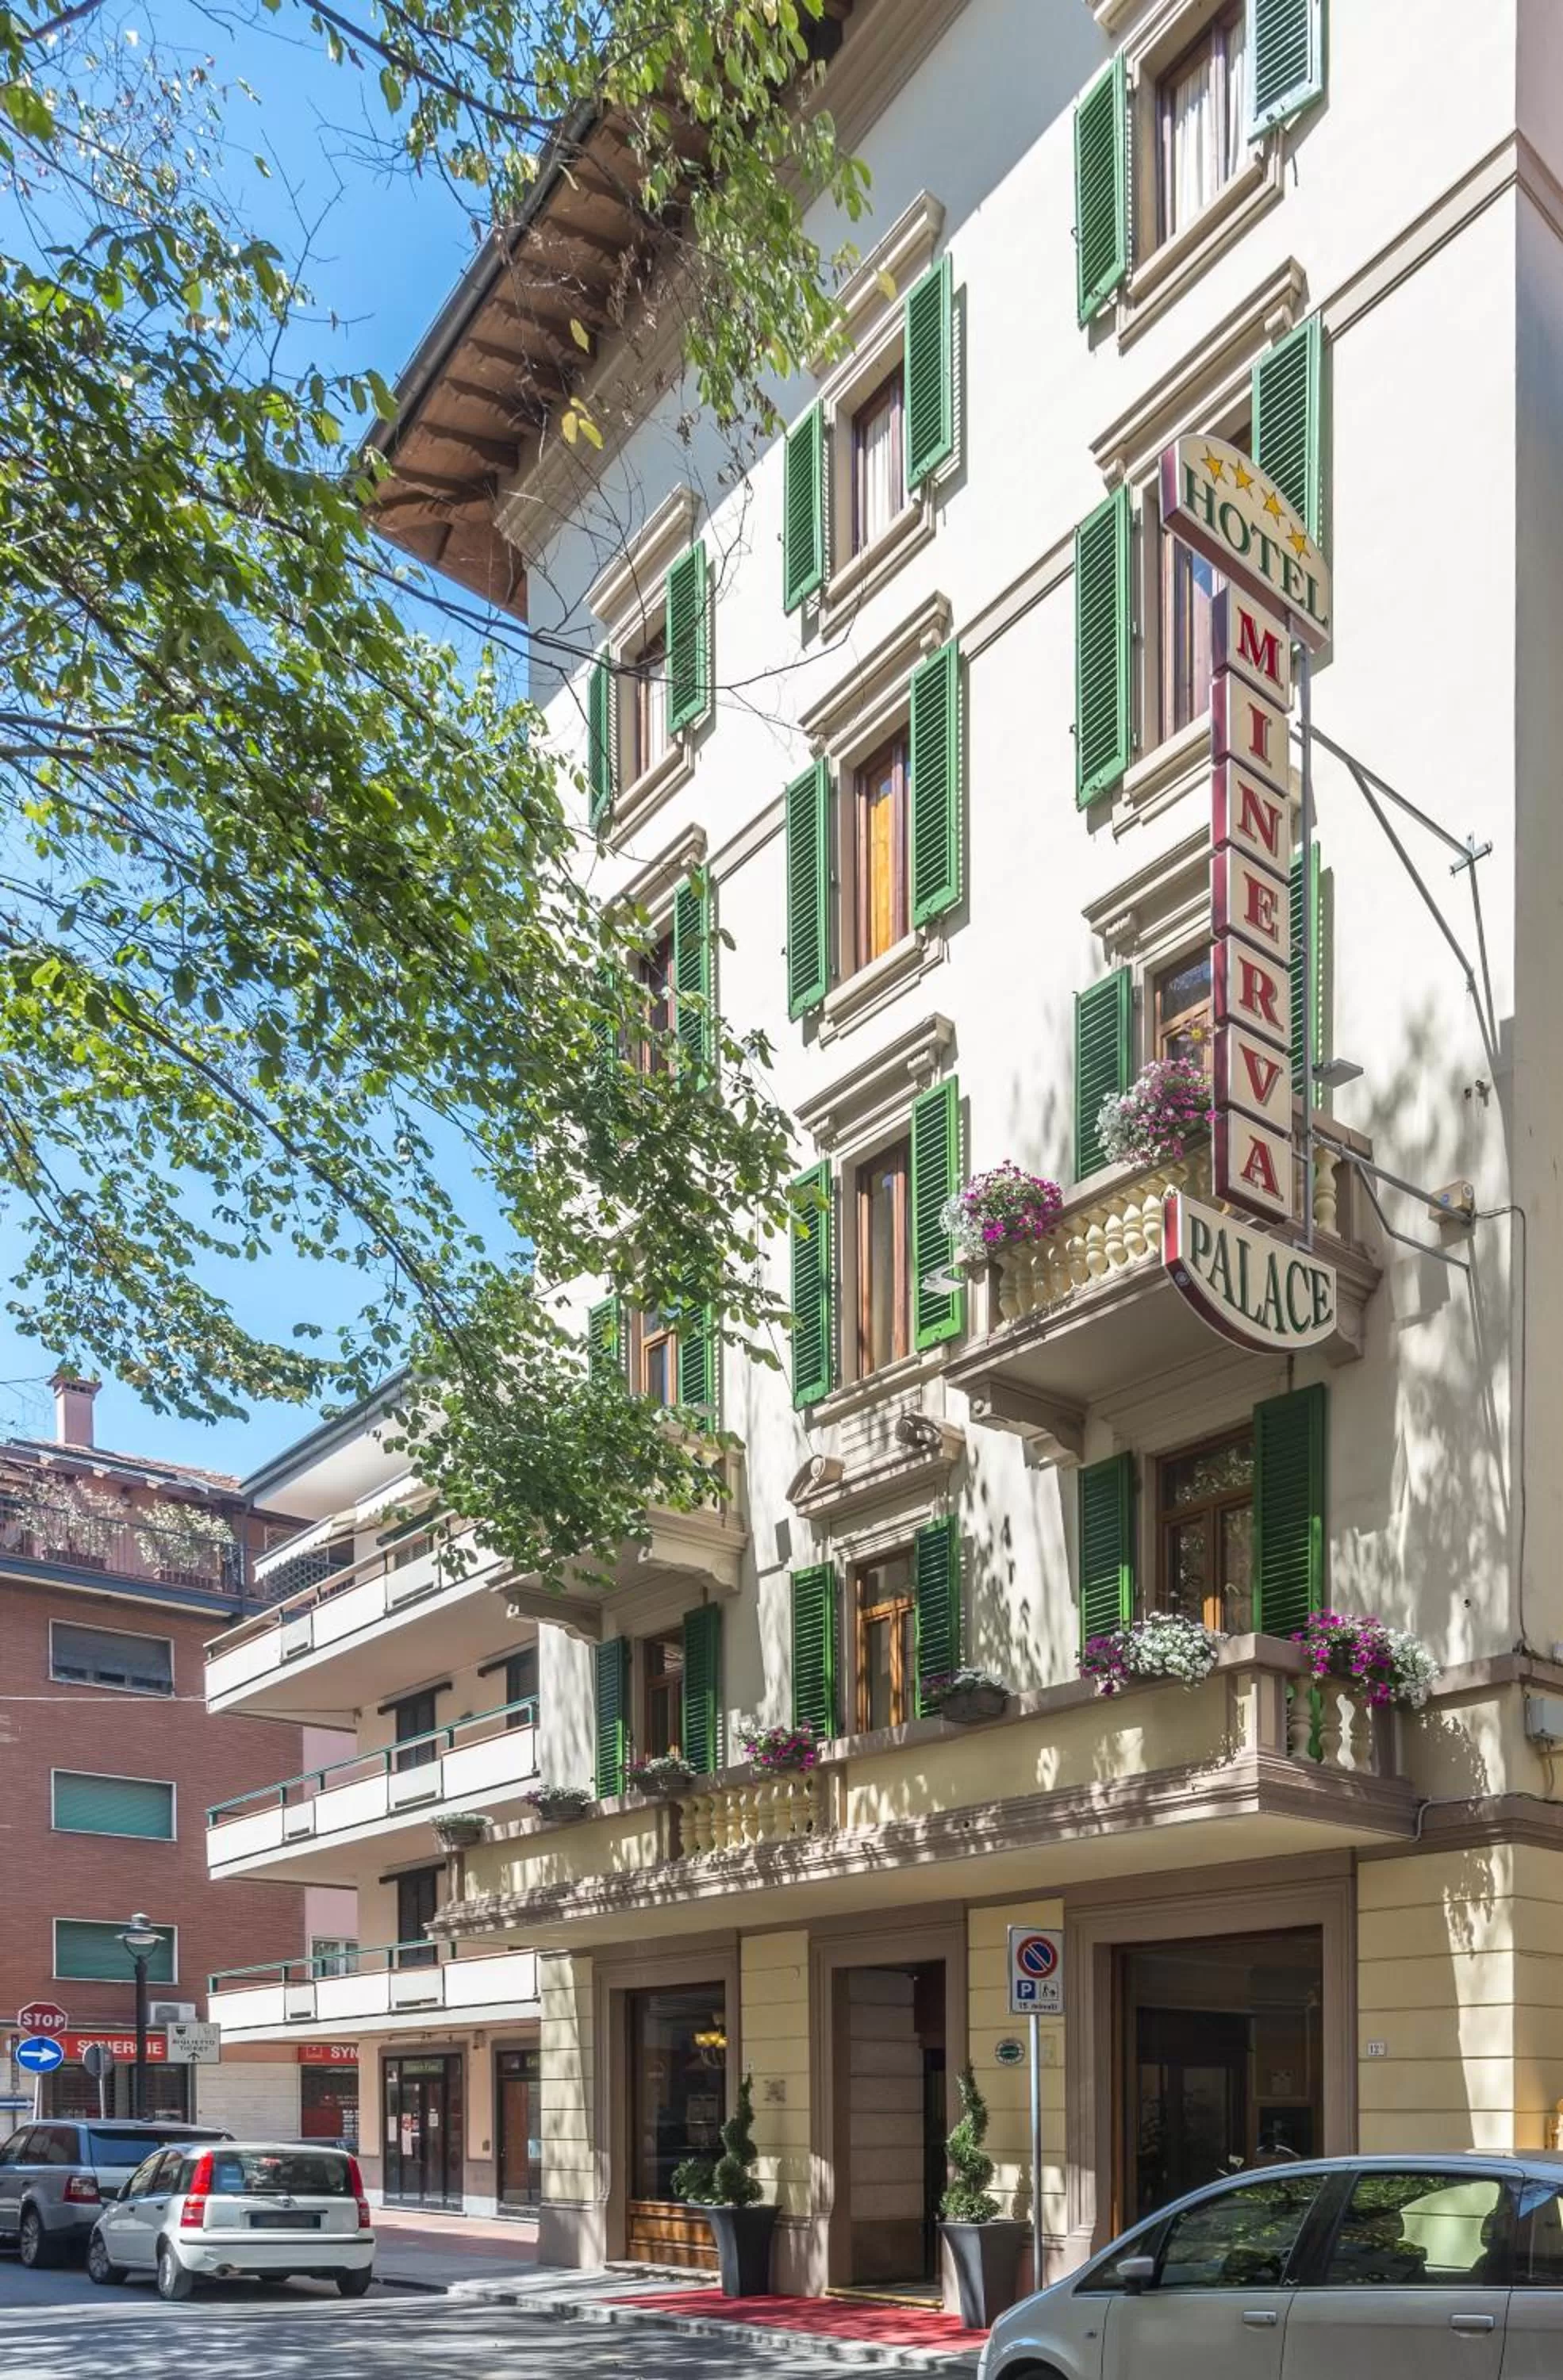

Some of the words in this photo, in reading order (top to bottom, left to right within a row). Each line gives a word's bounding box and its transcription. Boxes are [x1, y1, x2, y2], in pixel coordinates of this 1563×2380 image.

[1182, 460, 1328, 628] HOTEL
[1236, 605, 1285, 1202] MINERVA
[1189, 1214, 1333, 1334] PALACE
[22, 2013, 64, 2027] STOP
[1020, 1983, 1032, 1998] P
